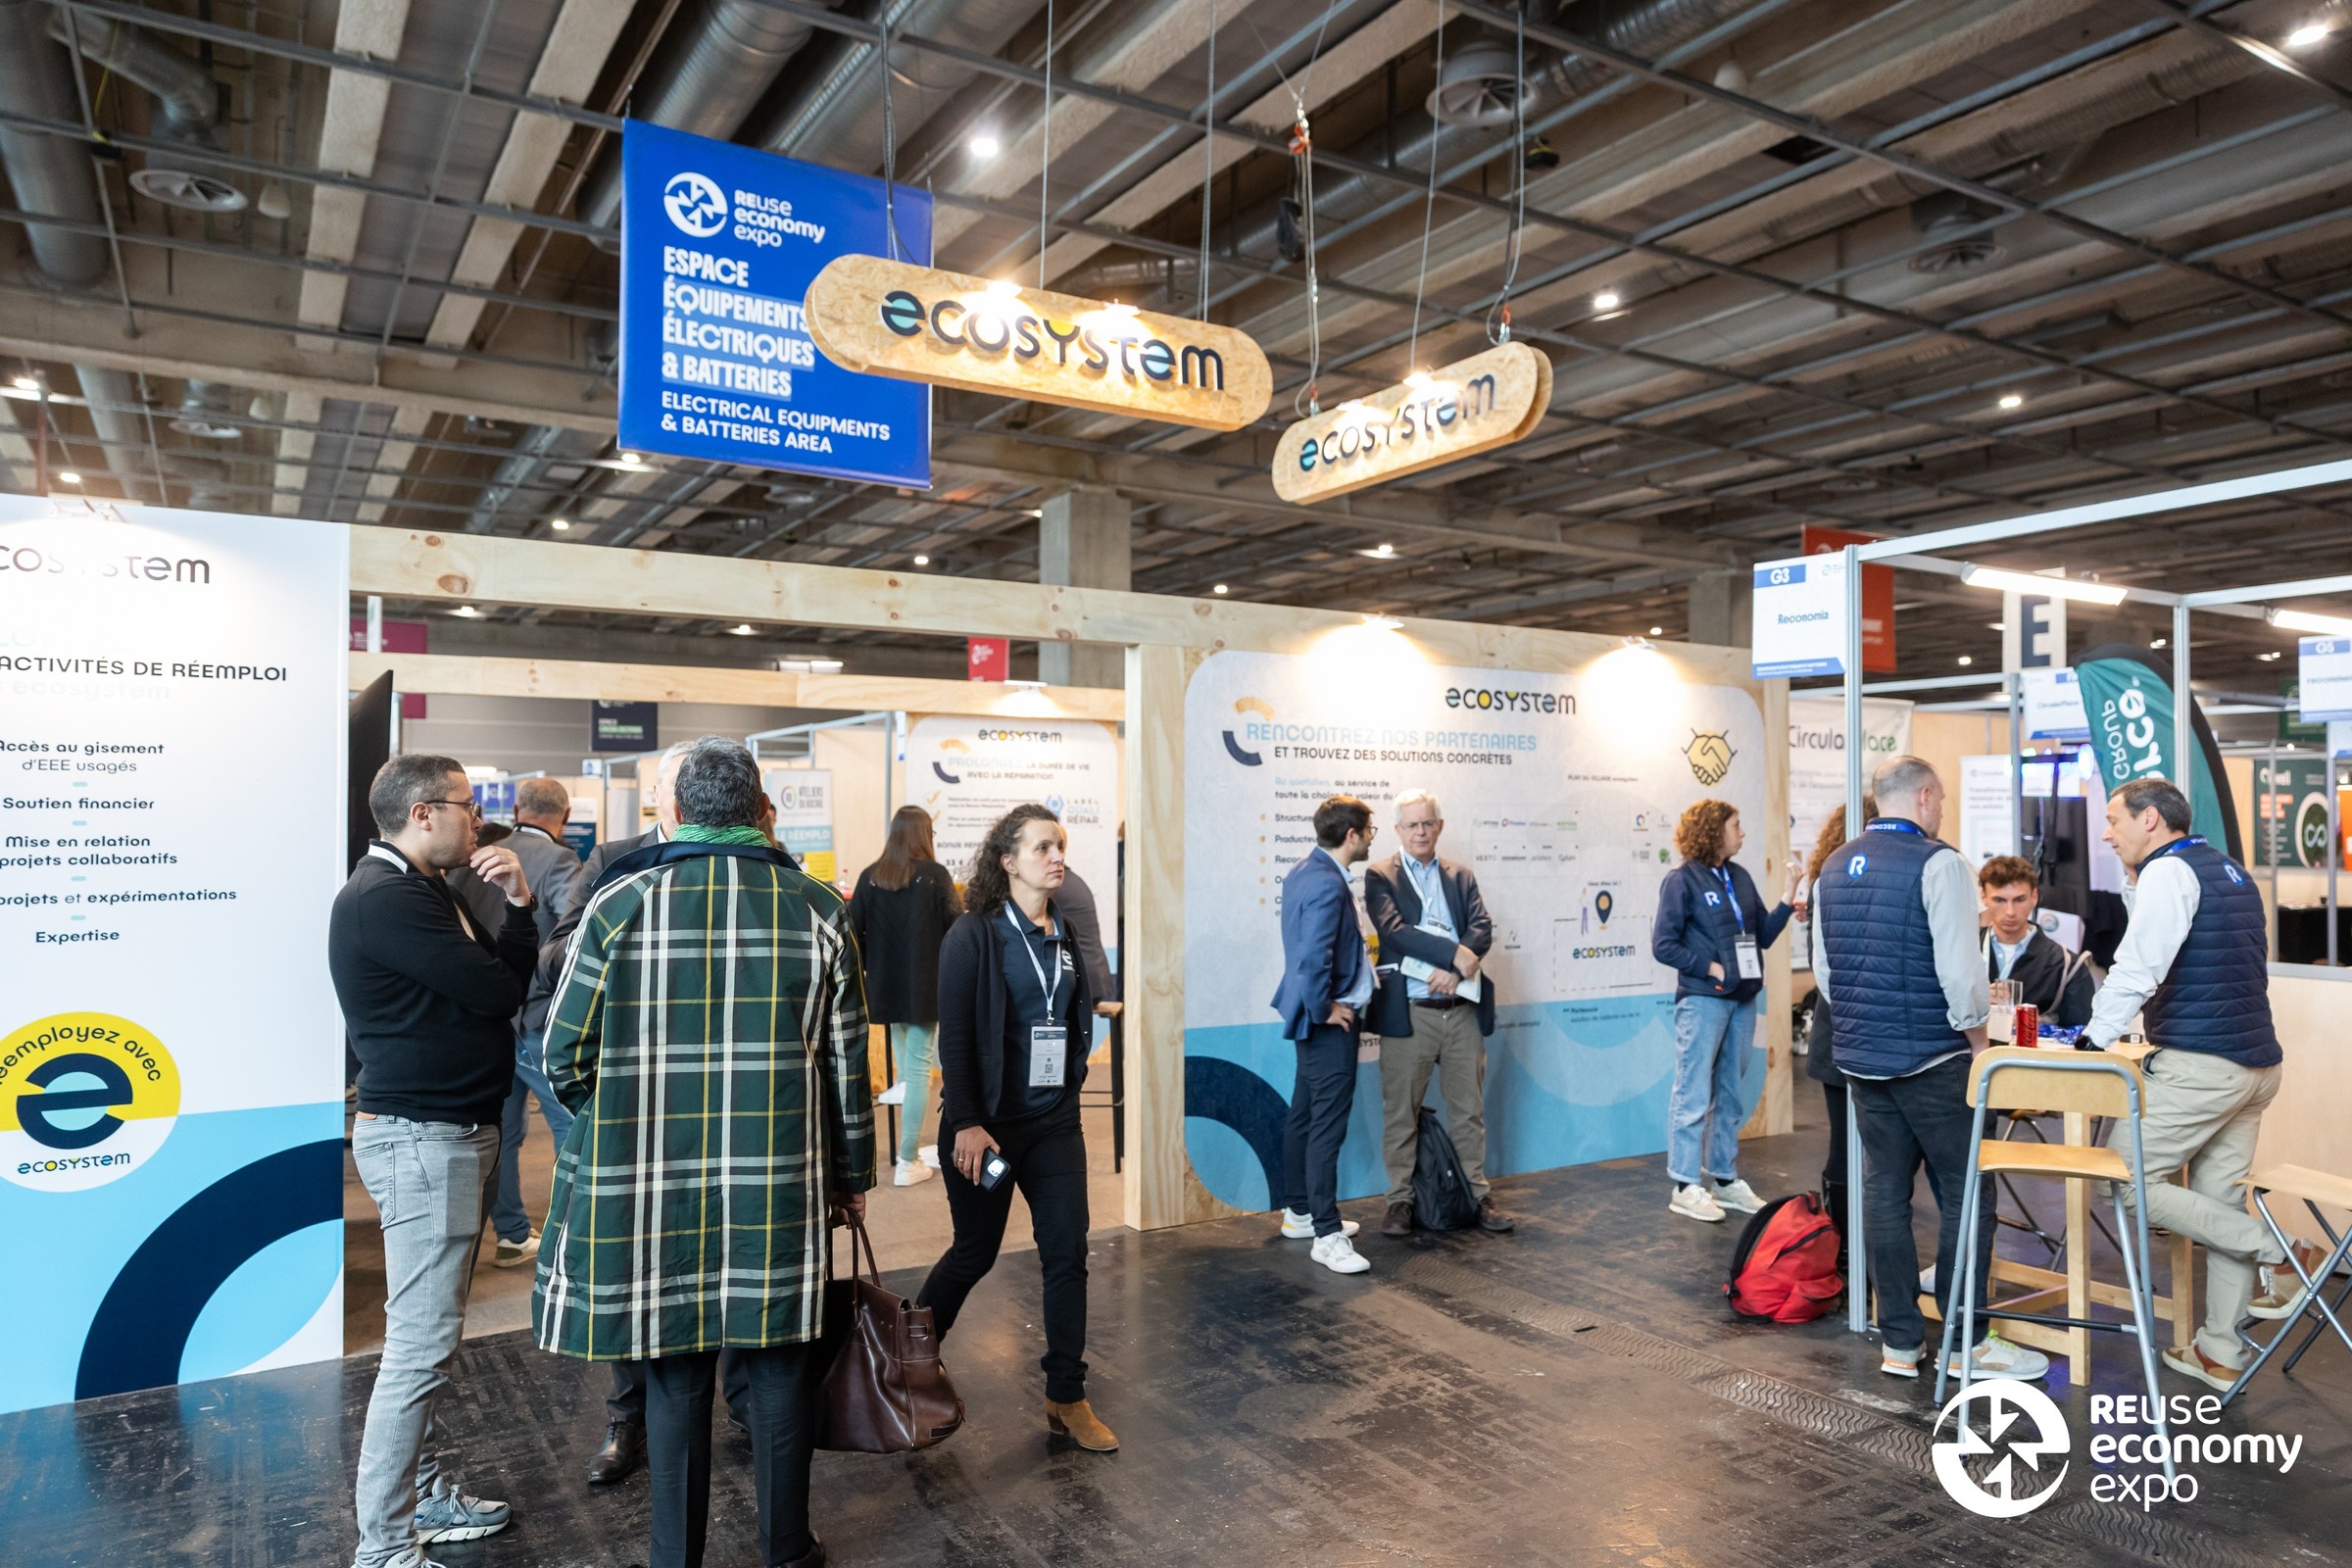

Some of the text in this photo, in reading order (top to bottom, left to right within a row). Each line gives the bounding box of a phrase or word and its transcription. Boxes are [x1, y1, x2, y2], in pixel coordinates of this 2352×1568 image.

[734, 208, 826, 244] economy
[734, 223, 783, 248] expo
[663, 245, 749, 288] ESPACE
[662, 308, 814, 368] ÉLECTRIQUES
[882, 290, 1224, 391] ecosystem
[662, 352, 792, 397] & BATTERIES
[662, 390, 890, 441] ELECTRICAL EQUIPMENTS
[1298, 372, 1494, 472] ecosystem
[661, 414, 832, 454] & BATTERIES AREA
[1770, 566, 1790, 585] G3
[1778, 610, 1829, 625] Reconomia
[2021, 594, 2051, 667] E
[133, 662, 163, 676] DE
[172, 660, 286, 681] RÉEMPLOI
[1446, 687, 1576, 714] ecosystem
[978, 729, 1062, 743] ecosystem
[1247, 722, 1537, 752] RENCONTREZ NOS PARTENAIRES
[56, 743, 77, 753] au
[84, 741, 165, 756] gisement
[1275, 747, 1512, 764] ET TROUVEZ DES SOLUTIONS CONCRÈTES
[22, 759, 137, 774] d'EEE usagés
[3, 797, 155, 809] Soutien financier
[1300, 790, 1308, 799] la
[1356, 791, 1380, 801] valeur
[1067, 814, 1099, 824] RÉPAR
[5, 835, 151, 848] Mise en relation
[0, 853, 177, 869] projets collaboratifs
[1848, 856, 1866, 875] R
[2225, 864, 2242, 884] R
[65, 894, 82, 904] et
[87, 889, 237, 906] expérimentations
[1704, 891, 1721, 906] R
[35, 930, 120, 945] Expertise
[1573, 945, 1636, 959] ecosystem
[123, 1040, 162, 1082] avec
[18, 1152, 130, 1174] ecosystem
